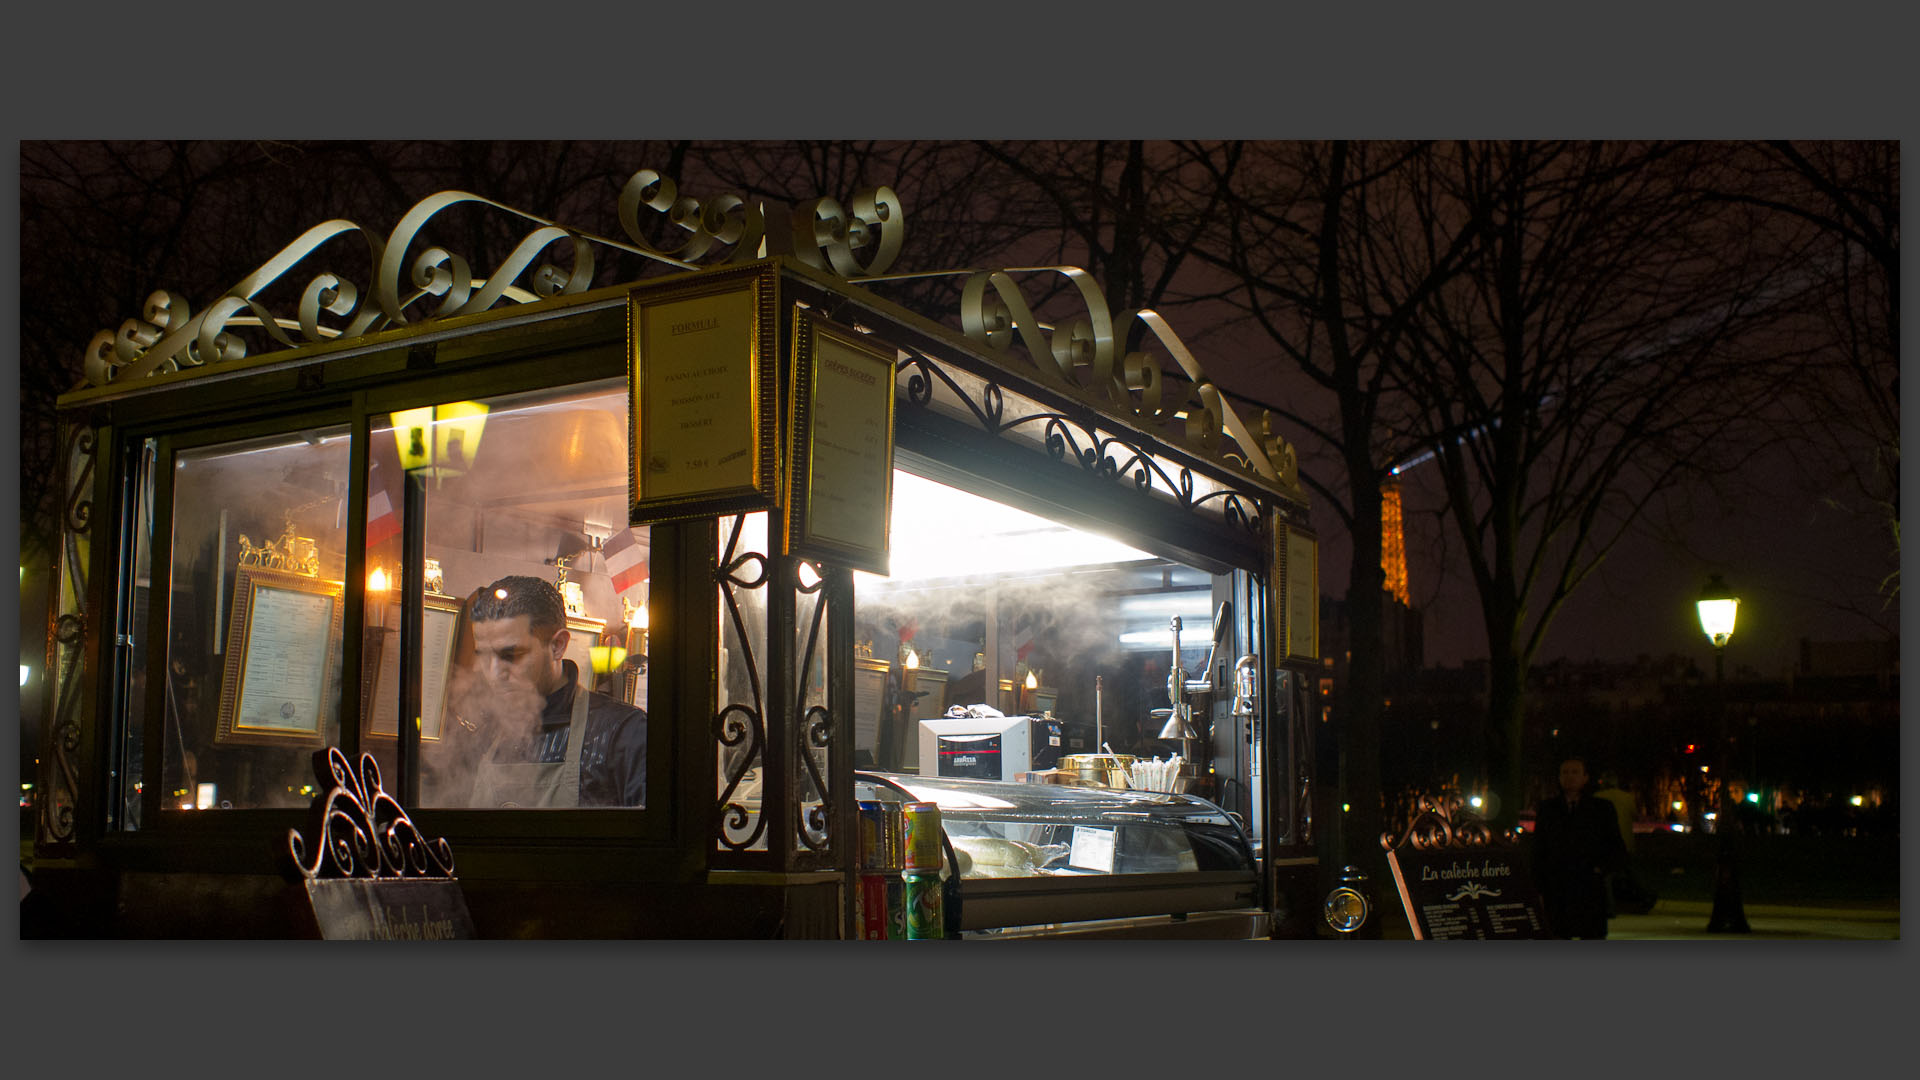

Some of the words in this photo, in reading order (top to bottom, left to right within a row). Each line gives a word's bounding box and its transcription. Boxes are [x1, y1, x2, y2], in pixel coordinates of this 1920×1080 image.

[671, 317, 720, 335] FORMULE
[1422, 865, 1438, 881] La
[1440, 861, 1479, 880] calèche
[1481, 860, 1511, 877] dorée
